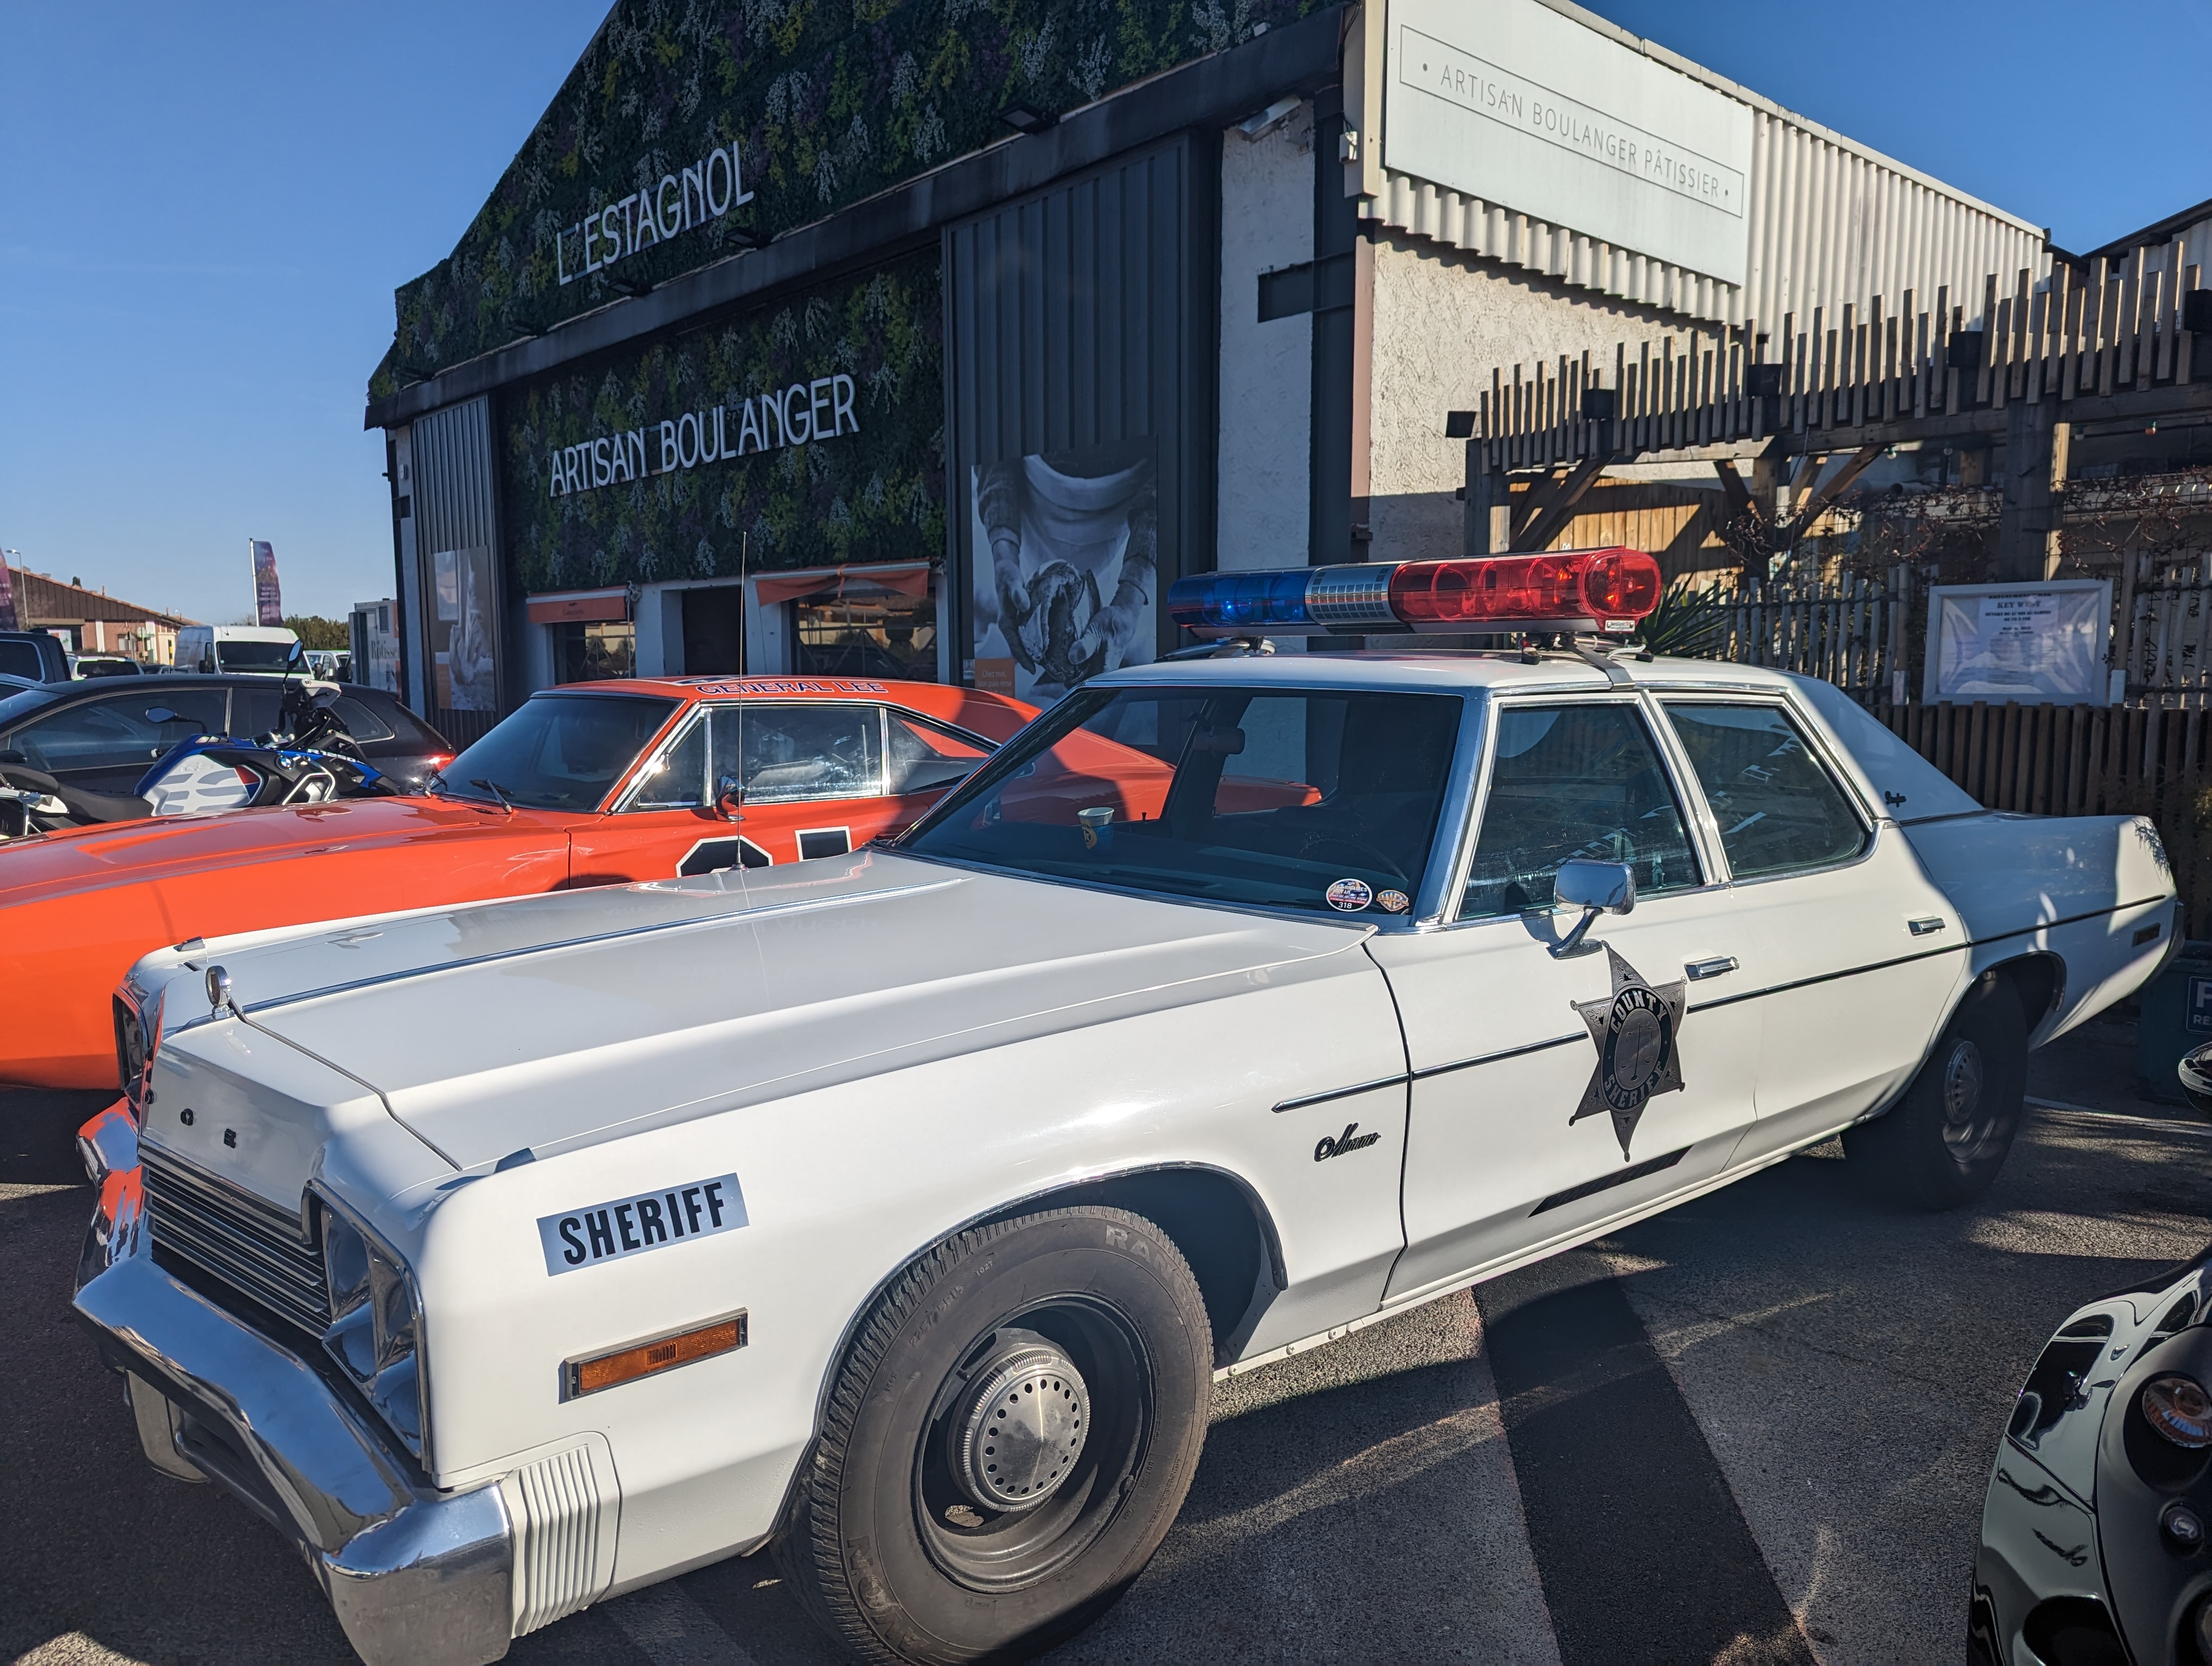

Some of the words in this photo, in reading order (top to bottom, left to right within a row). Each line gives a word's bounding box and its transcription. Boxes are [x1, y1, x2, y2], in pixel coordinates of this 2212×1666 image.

[1441, 64, 1523, 119] ARTISAN
[1533, 102, 1637, 165] BOULANGER
[1645, 149, 1719, 197] PÂTISSIER
[557, 140, 754, 286] L'ESTAGNOL
[549, 428, 647, 498] ARTISAN
[661, 374, 860, 473] BOULANGER
[696, 682, 835, 695] GENERAL
[832, 682, 889, 693] LEE
[1610, 990, 1667, 1034] COUNTY
[2194, 1014, 2212, 1026] RE
[1605, 1060, 1664, 1108] SHERIFF
[1314, 1122, 1381, 1162] Monaco
[559, 1182, 724, 1265] SHERIFF
